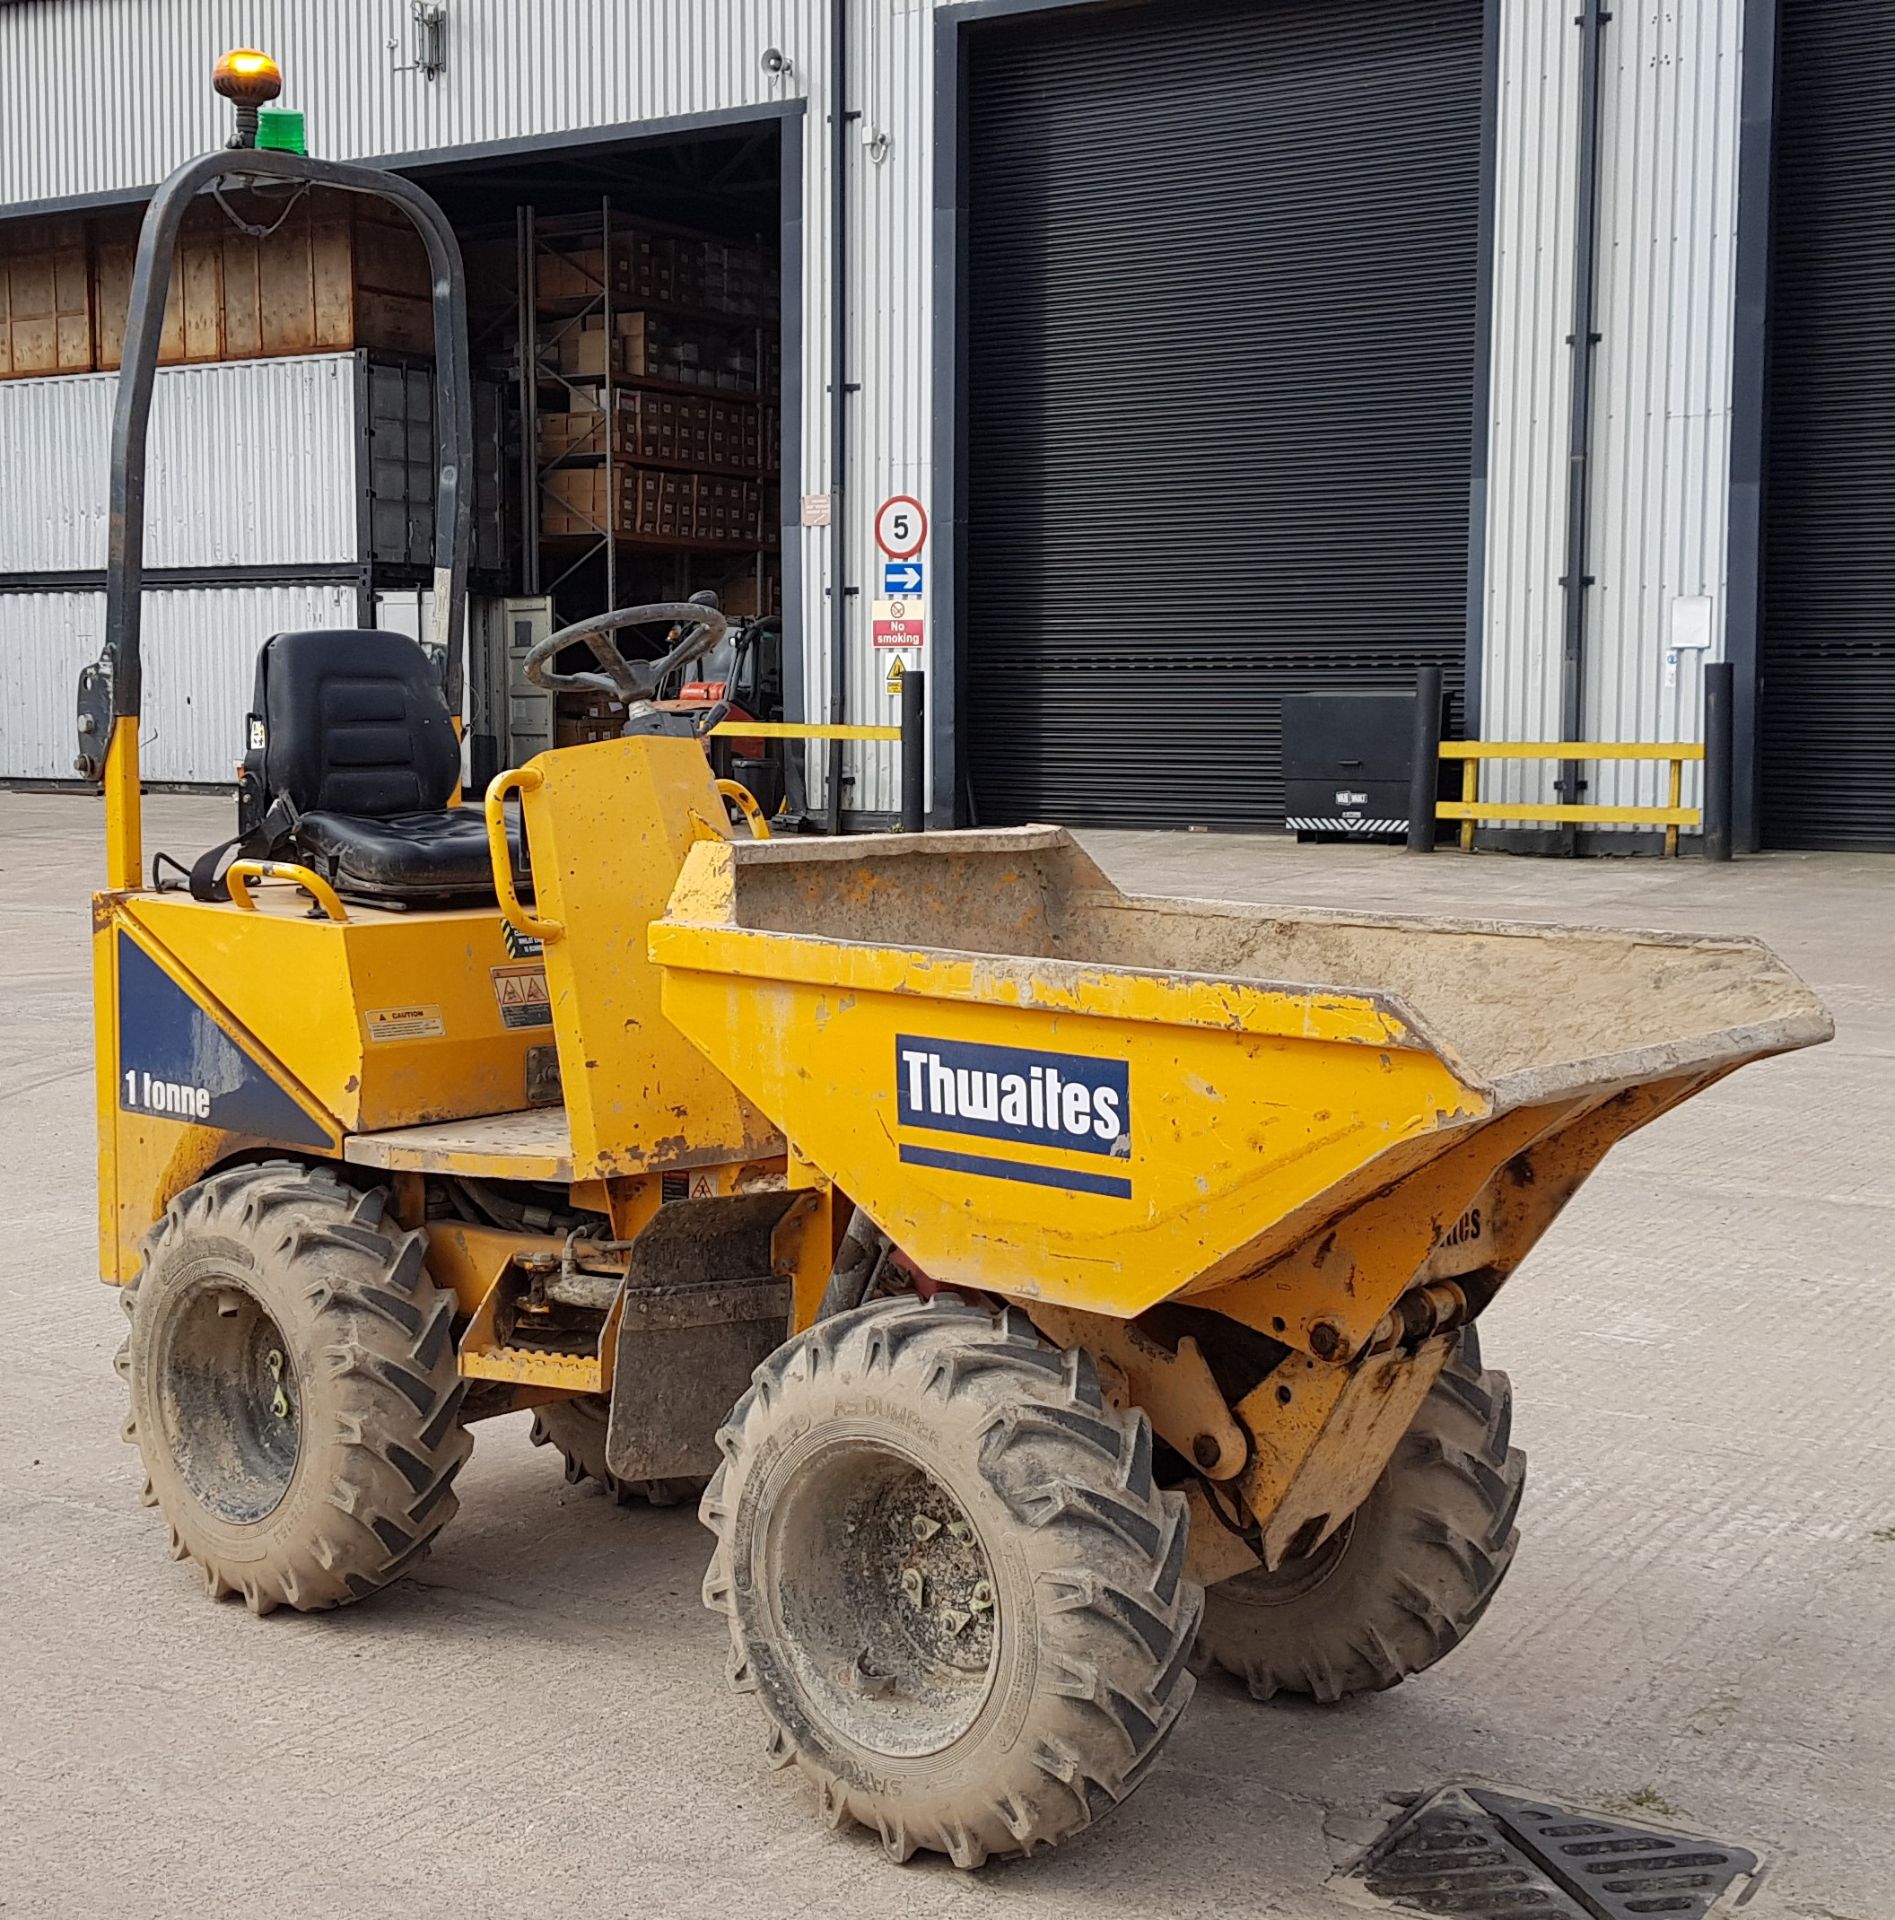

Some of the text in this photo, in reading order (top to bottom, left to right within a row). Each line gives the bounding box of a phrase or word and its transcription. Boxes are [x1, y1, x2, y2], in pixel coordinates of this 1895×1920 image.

[893, 514, 909, 540] 5
[890, 621, 905, 632] No
[877, 633, 920, 645] smoking
[391, 1010, 424, 1020] CAUTION
[125, 1069, 210, 1119] 1 tonne
[902, 1050, 1121, 1140] Thwaites
